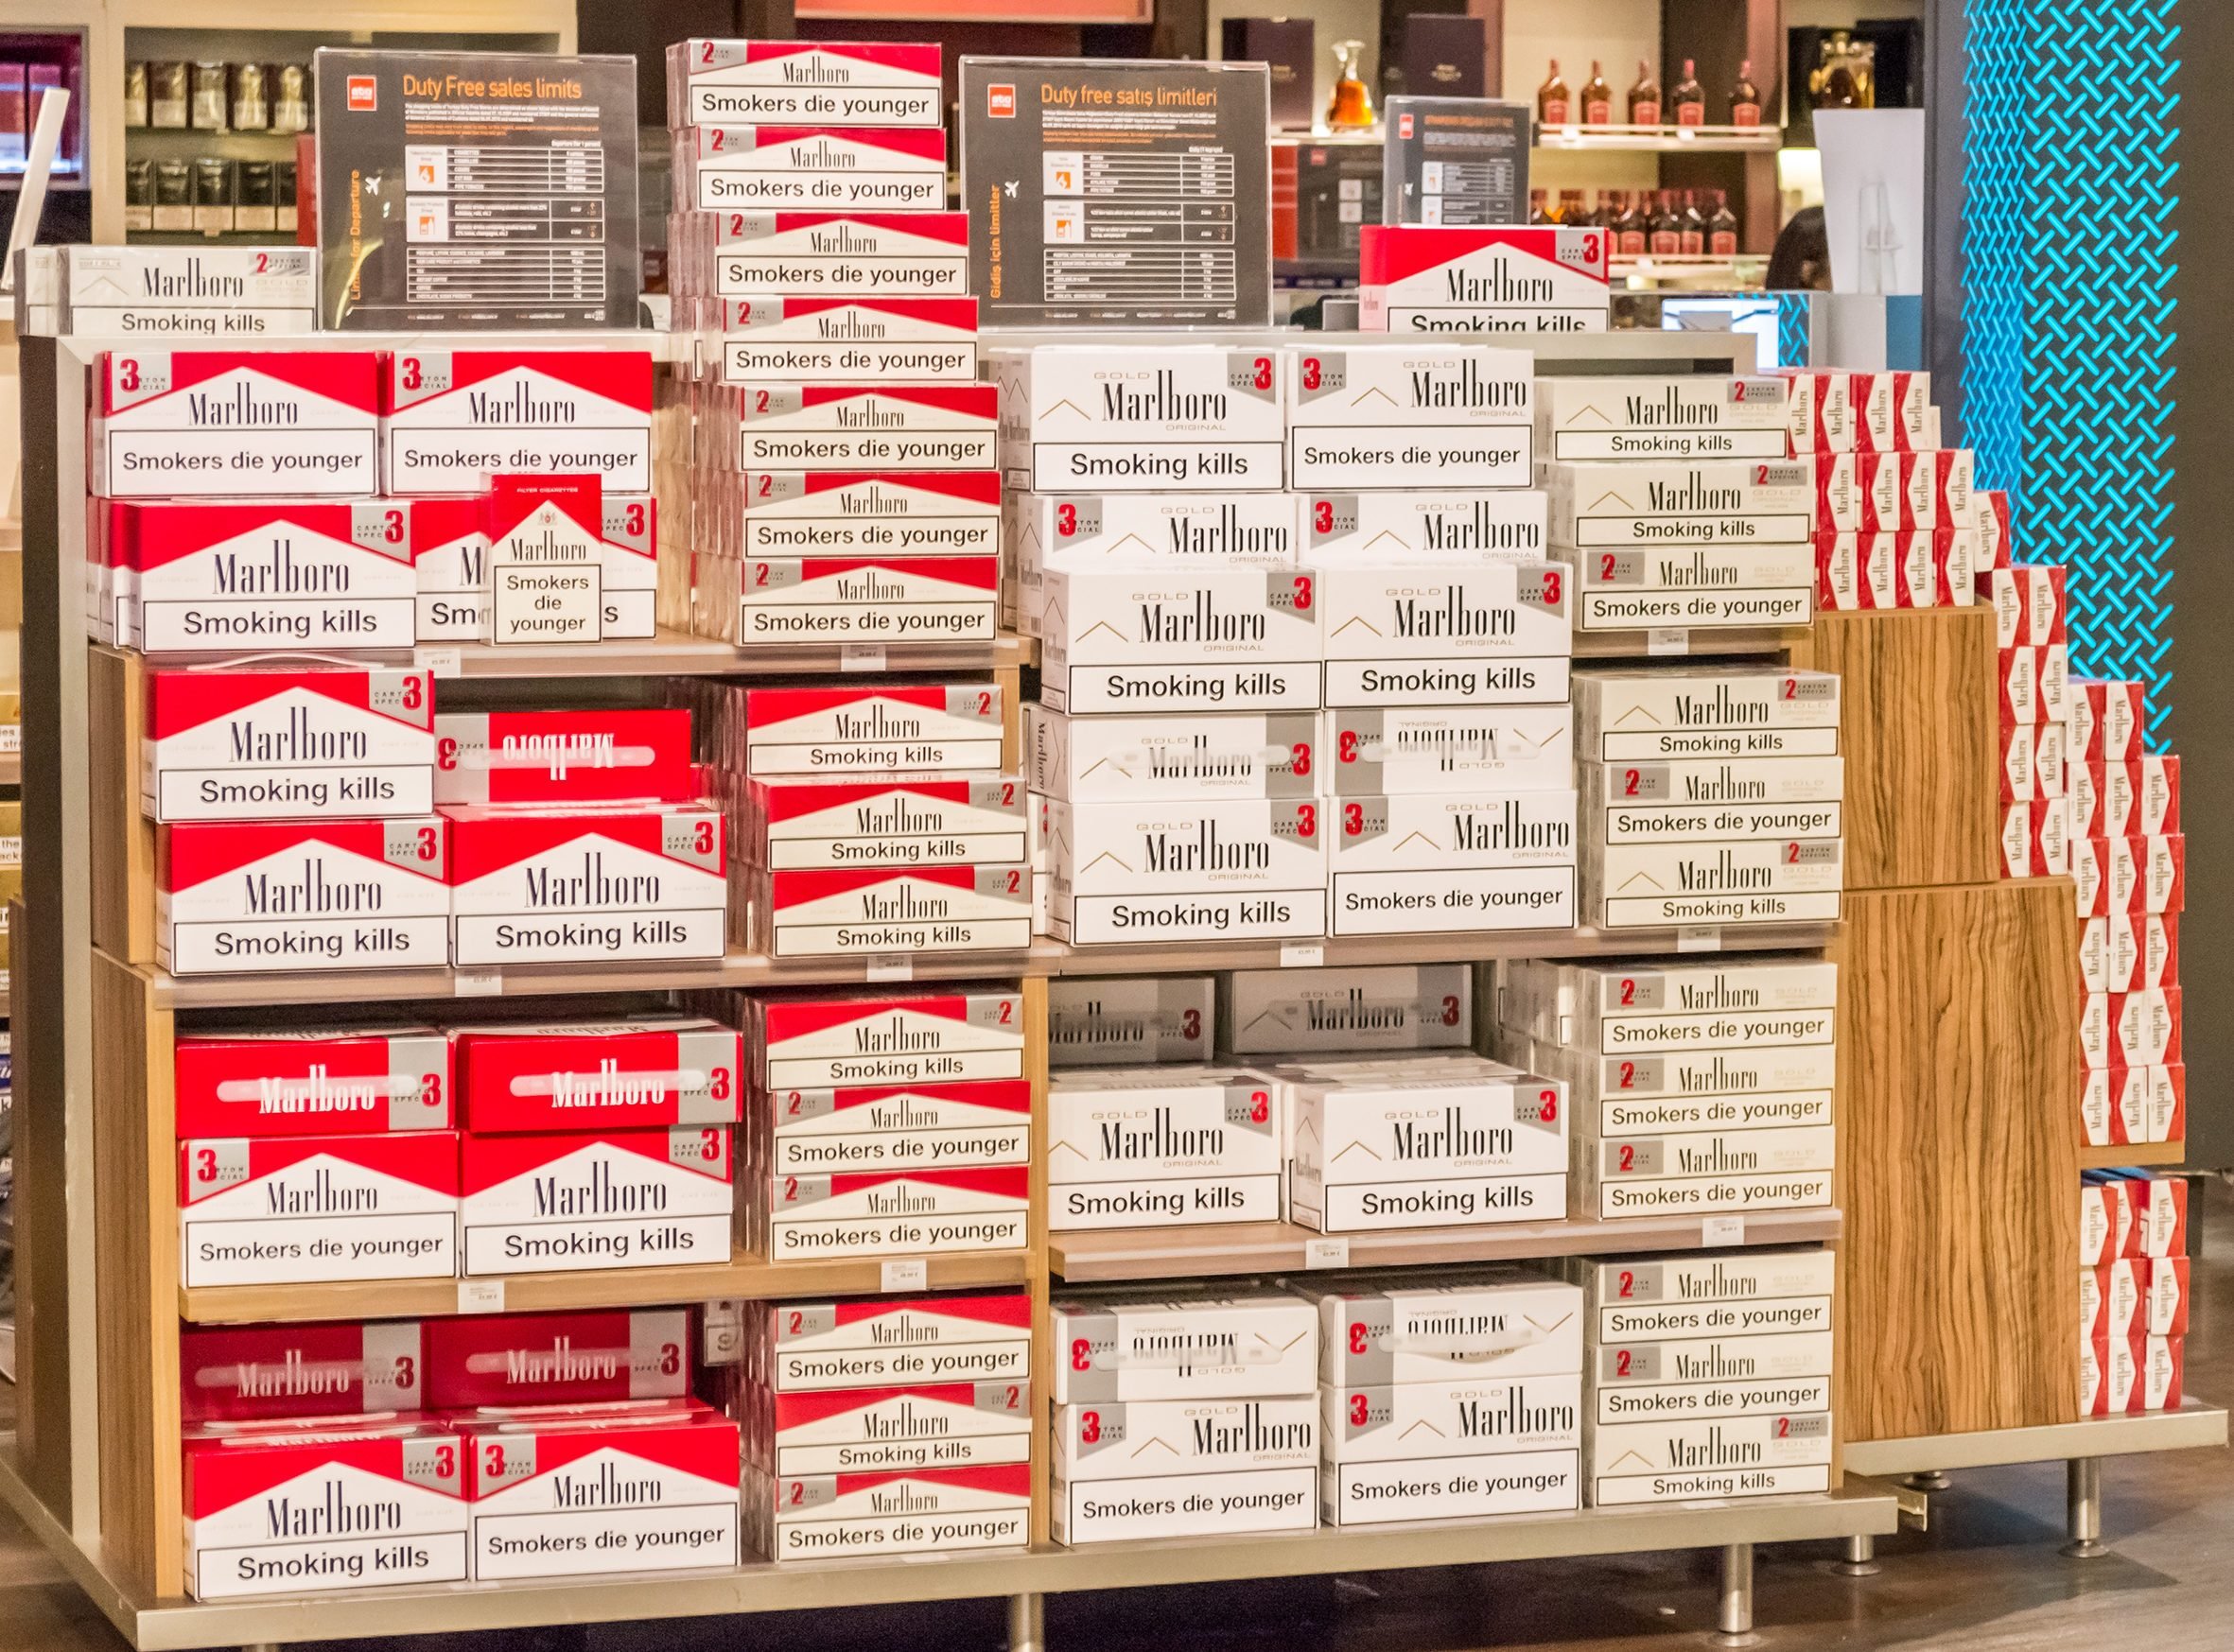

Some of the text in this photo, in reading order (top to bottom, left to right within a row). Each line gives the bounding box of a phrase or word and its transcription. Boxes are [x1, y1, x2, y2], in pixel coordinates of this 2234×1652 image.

[703, 42, 714, 63] 2
[784, 56, 848, 82] Marlboro
[403, 75, 582, 101] Duty Free sales limits
[703, 94, 929, 116] Smokers die younger
[1041, 84, 1217, 108] Duty free satış limitleri
[812, 226, 876, 252] Marlboro
[1583, 234, 1599, 264] 3
[145, 258, 242, 296] Marlboro
[729, 265, 956, 287] Smokers die younger
[1448, 258, 1552, 302] Marlboro
[122, 314, 265, 334] Smoking kills
[1412, 315, 1585, 332] Smoking kills
[121, 359, 140, 392] 3
[1254, 357, 1272, 391] 3
[1413, 359, 1526, 407] Marlboro
[190, 382, 297, 425] Marlboro
[470, 381, 574, 423] Marlboro
[1105, 370, 1226, 420] Marlboro
[1627, 386, 1718, 425] Marlboro
[1736, 382, 1744, 402] 2
[837, 400, 903, 426] Marlboro
[124, 452, 362, 472] Smokers die younger
[1305, 447, 1520, 467] Smokers die younger
[1612, 436, 1732, 454] Smoking kills
[1072, 453, 1248, 479] Smoking kills
[1649, 471, 1740, 511] Marlboro
[1058, 503, 1076, 537] 3
[1171, 504, 1286, 552] Marlboro
[1425, 501, 1538, 549] Marlboro
[512, 530, 585, 561] Marlboro
[216, 539, 348, 593] Marlboro
[508, 575, 588, 590] Smokers
[1661, 552, 1737, 585] Marlboro
[535, 596, 561, 610] die
[838, 572, 904, 600] Marlboro
[184, 610, 376, 638] Smoking kills
[1143, 590, 1265, 642] Marlboro
[1396, 585, 1514, 636] Marlboro
[1594, 599, 1802, 617] Smokers die younger
[511, 619, 585, 634] younger
[402, 675, 423, 710] 3
[1362, 668, 1535, 695] Smoking kills
[979, 692, 991, 715] 2
[1676, 685, 1768, 724] Marlboro
[232, 706, 366, 761] Marlboro
[836, 704, 919, 739] Marlboro
[502, 733, 615, 781] Marlboro
[812, 747, 942, 766] Smoking kills
[201, 777, 394, 806] Smoking kills
[1456, 801, 1568, 849] Marlboro
[1618, 813, 1831, 832] Smokers die younger
[1146, 820, 1268, 872] Marlboro
[246, 859, 381, 913] Marlboro
[527, 852, 658, 906] Marlboro
[1680, 850, 1771, 890] Marlboro
[864, 885, 947, 919] Marlboro
[1347, 891, 1562, 910] Smokers die younger
[1664, 899, 1785, 918] Smoking kills
[838, 927, 970, 947] Smoking kills
[1621, 979, 1635, 1006] 2
[1681, 975, 1758, 1009] Marlboro
[1307, 988, 1404, 1031] Marlboro
[856, 1017, 939, 1052] Marlboro
[259, 1064, 375, 1114] Marlboro
[551, 1058, 666, 1108] Marlboro
[711, 1067, 730, 1102] 3
[1250, 1090, 1269, 1124] 3
[789, 1139, 1019, 1161] Smokers die younger
[1102, 1107, 1223, 1159] Marlboro
[1395, 1107, 1511, 1159] Marlboro
[1680, 1139, 1756, 1173] Marlboro
[269, 1169, 376, 1213] Marlboro
[535, 1161, 666, 1215] Marlboro
[868, 1185, 934, 1213] Marlboro
[201, 1239, 443, 1261] Smokers die younger
[1679, 1263, 1755, 1297] Marlboro
[864, 1402, 948, 1437] Marlboro
[1184, 1407, 1238, 1416] GOLD
[1195, 1403, 1310, 1454] Marlboro
[1460, 1386, 1573, 1438] Marlboro
[840, 1443, 970, 1464] Smoking kills
[1669, 1426, 1760, 1467] Marlboro
[554, 1463, 660, 1506] Marlboro
[1352, 1474, 1566, 1499] Smokers die younger
[1653, 1473, 1774, 1494] Smoking kills
[269, 1481, 400, 1537] Marlboro
[1084, 1493, 1304, 1518] Smokers die younger
[238, 1546, 428, 1579] Smoking kills
